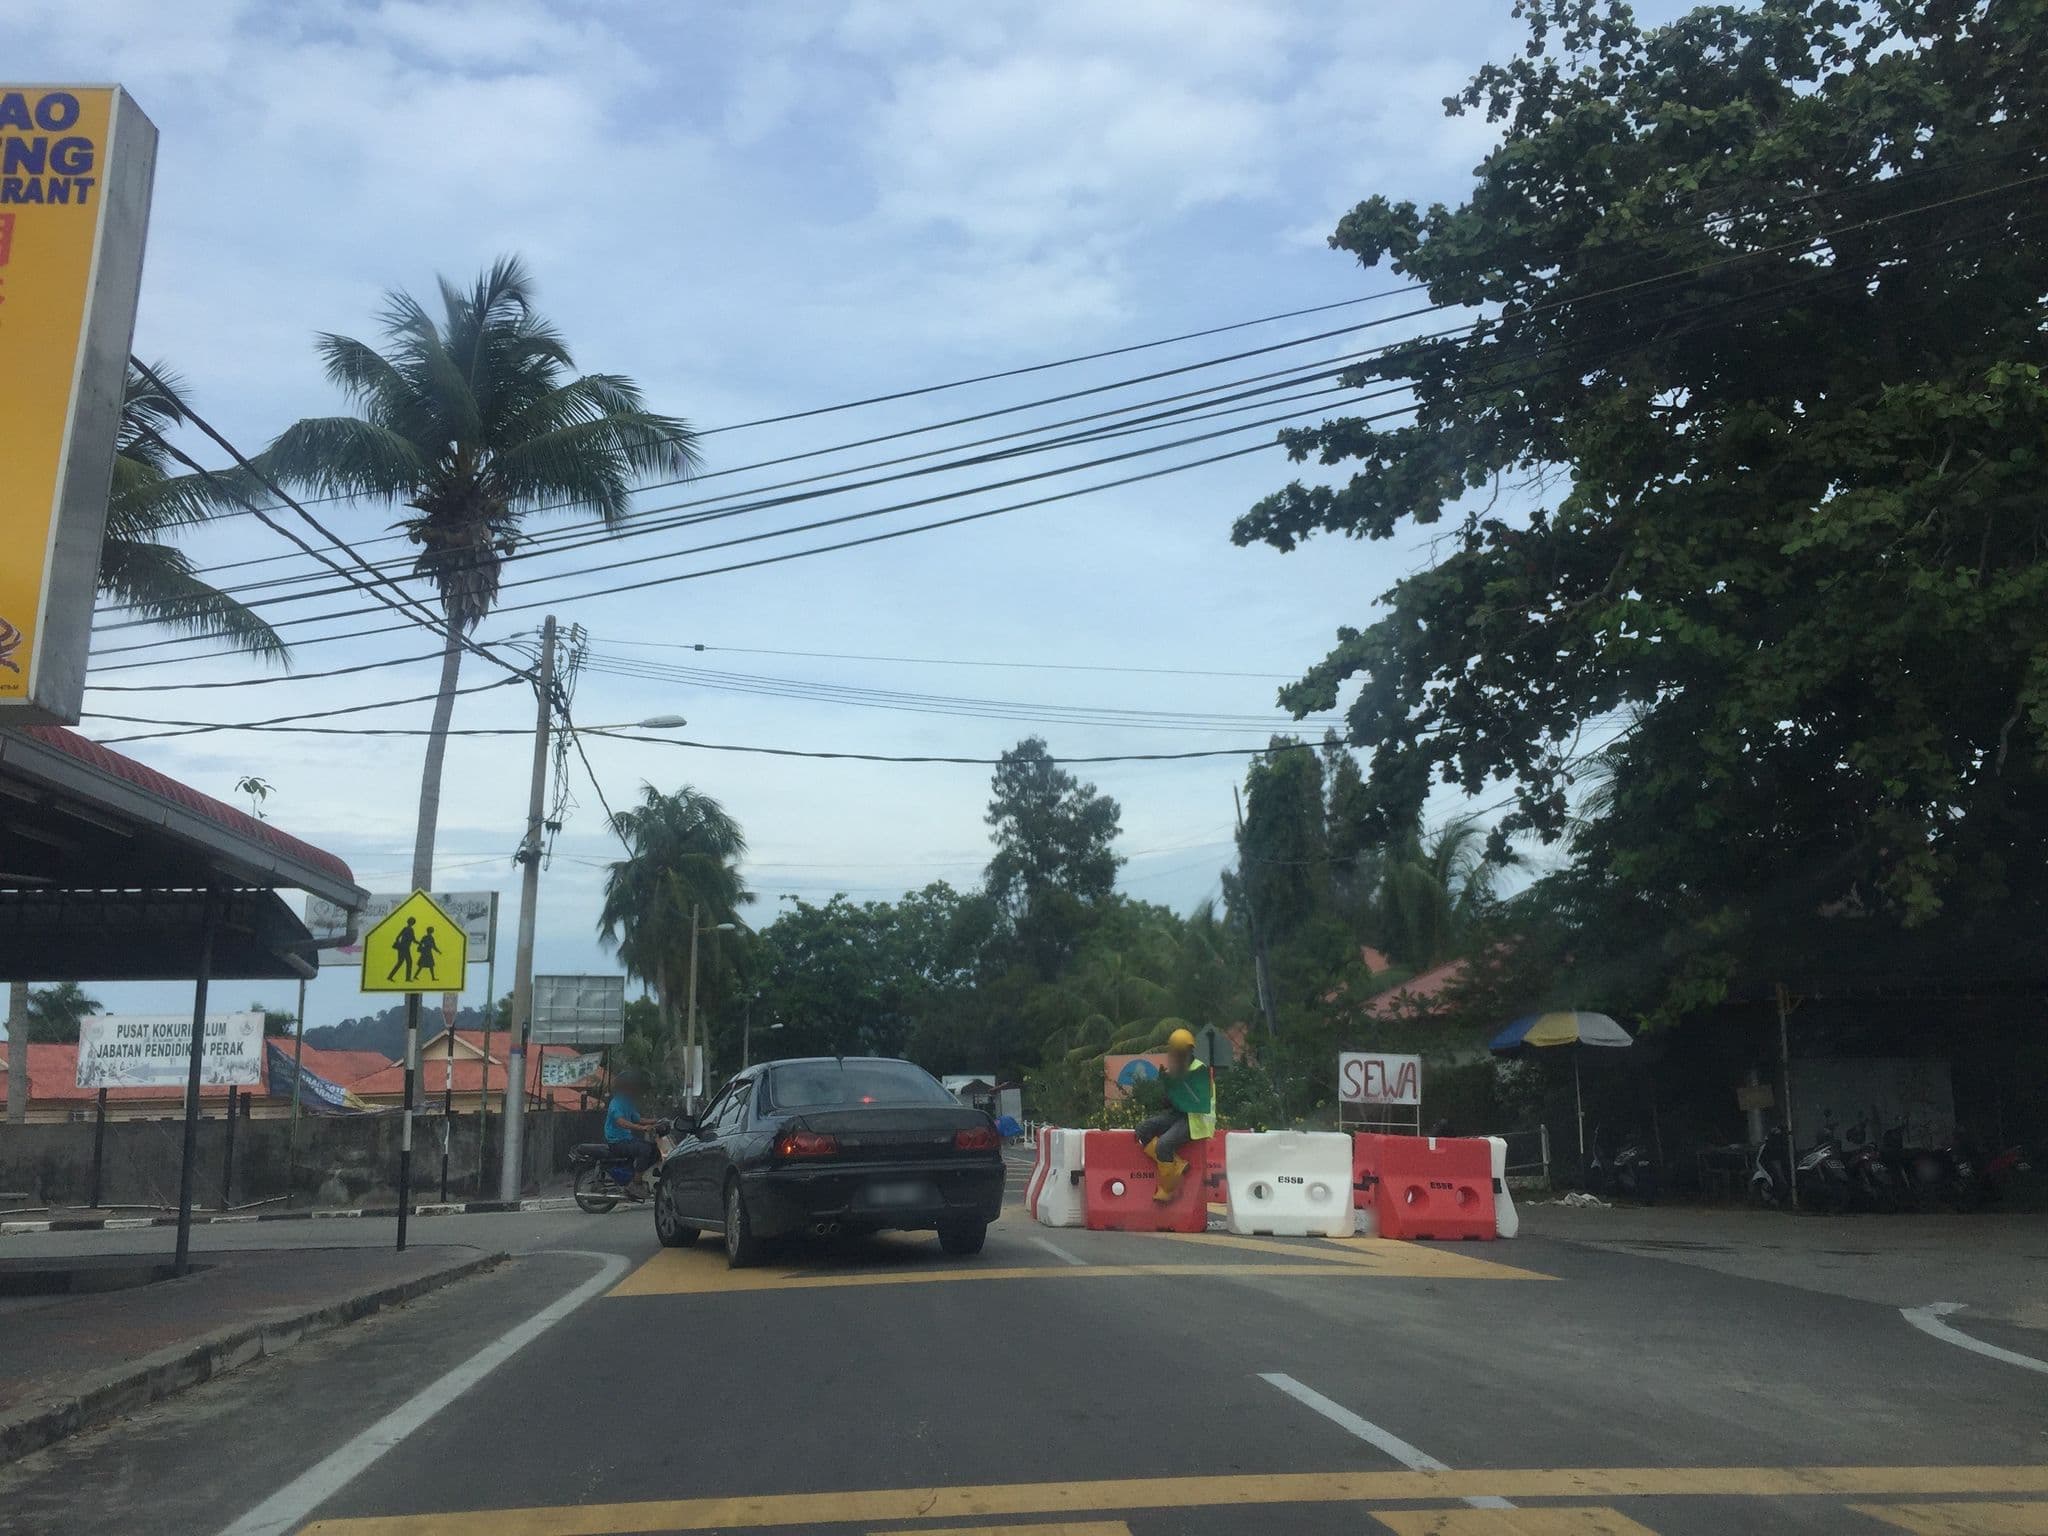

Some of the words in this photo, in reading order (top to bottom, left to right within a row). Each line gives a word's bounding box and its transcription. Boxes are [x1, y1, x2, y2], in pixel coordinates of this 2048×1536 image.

[0, 136, 94, 175] NG
[0, 177, 95, 204] RANT
[116, 1023, 150, 1039] PUSAT
[152, 1022, 227, 1038] KOKURILUM
[97, 1043, 142, 1059] JABATAN
[144, 1041, 207, 1058] PENDIDIKN
[209, 1040, 244, 1057] PERAK
[1342, 1059, 1418, 1100] SEWA
[1277, 1175, 1304, 1185] ESSB
